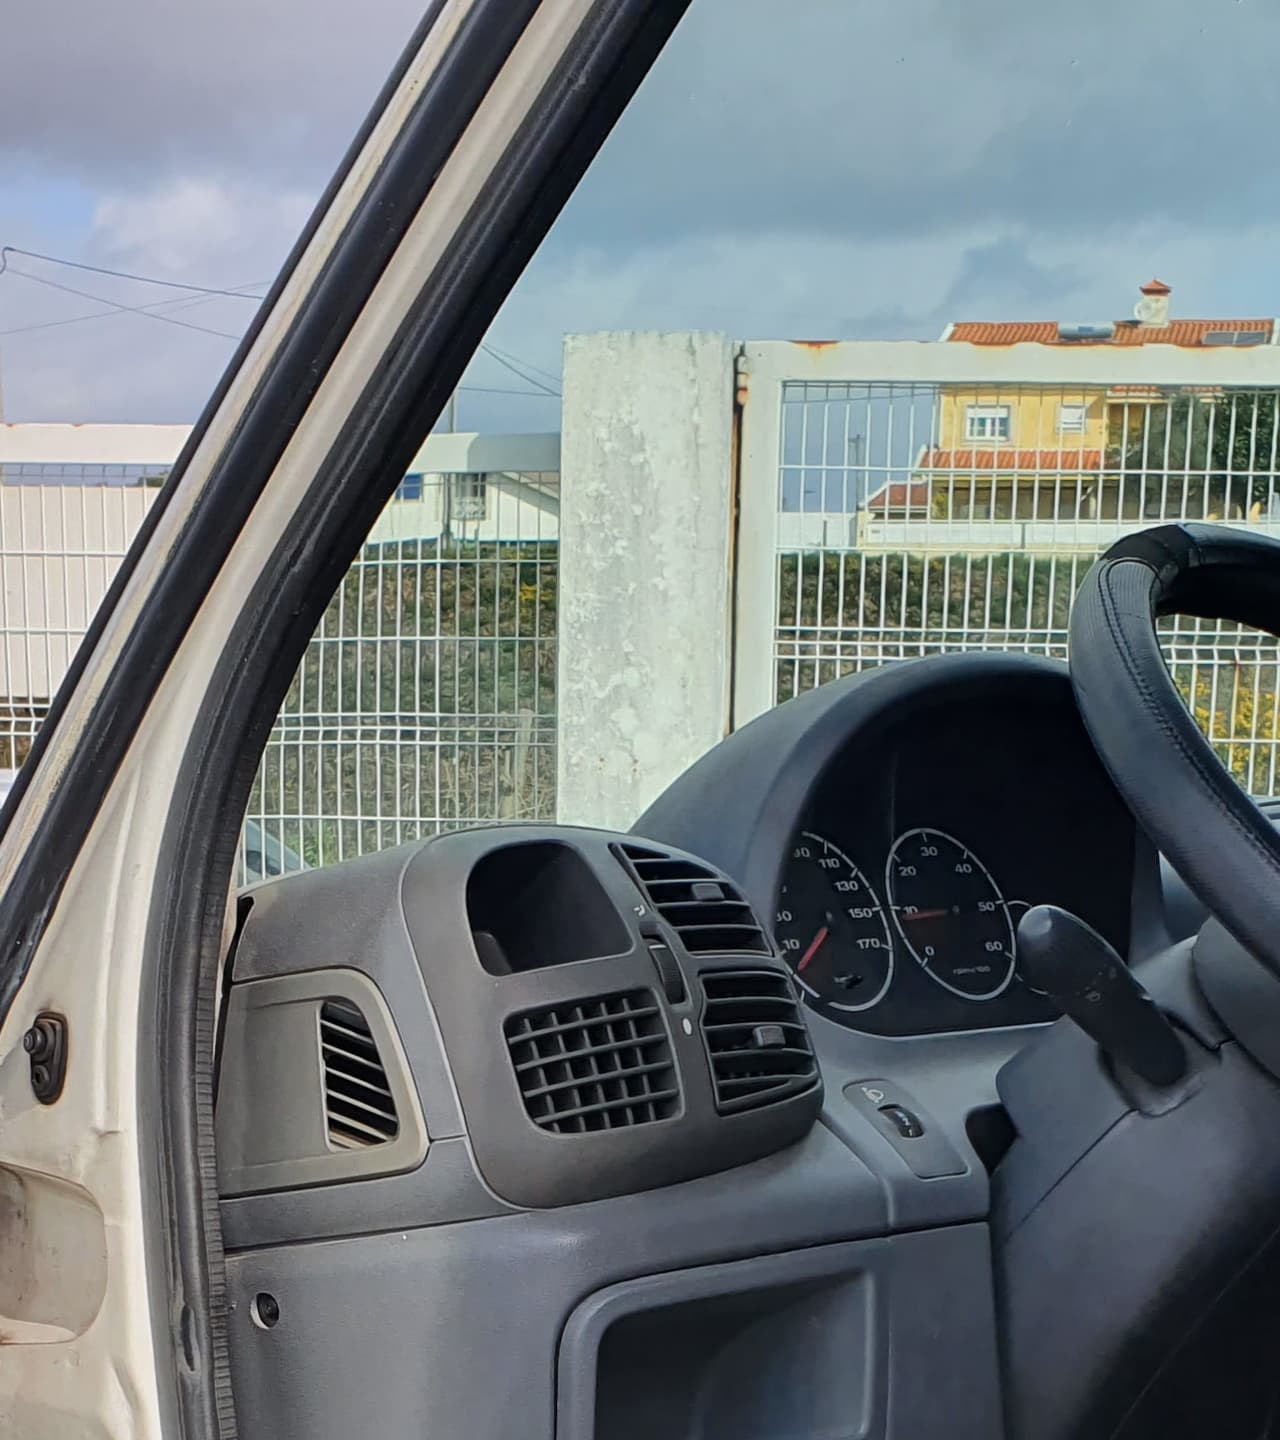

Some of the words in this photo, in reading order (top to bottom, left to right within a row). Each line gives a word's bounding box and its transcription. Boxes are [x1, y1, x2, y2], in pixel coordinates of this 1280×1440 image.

[920, 846, 938, 857] 30
[819, 857, 840, 869] 110
[955, 863, 972, 873] 40
[899, 865, 917, 876] 20
[835, 880, 859, 891] 130
[903, 905, 919, 915] 10
[977, 901, 996, 912] 50
[848, 907, 873, 918] 150
[783, 938, 800, 950] 10
[857, 937, 881, 949] 170
[985, 941, 1003, 952] 60
[924, 945, 935, 957] 0
